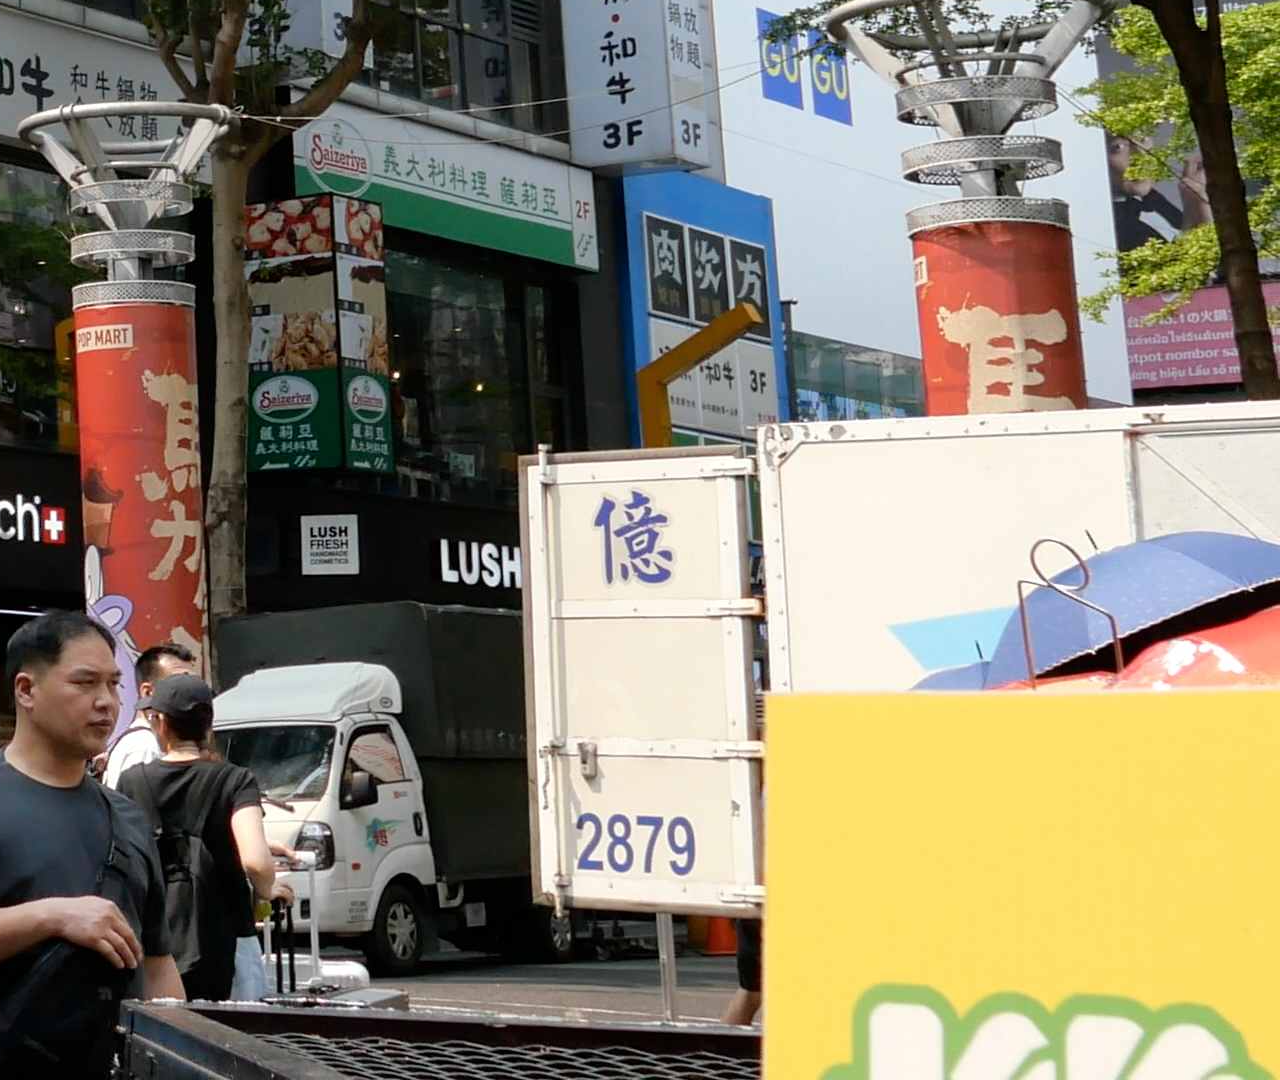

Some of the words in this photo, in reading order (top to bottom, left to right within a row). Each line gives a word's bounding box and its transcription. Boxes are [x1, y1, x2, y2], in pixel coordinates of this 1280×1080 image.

[763, 39, 799, 84] GU
[812, 53, 848, 101] GU
[602, 120, 643, 149] 3F
[681, 120, 702, 148] 3F
[311, 133, 368, 175] Saizeriya
[383, 145, 490, 199] 義大利料理
[575, 199, 590, 220] 2F
[94, 327, 130, 346] MART
[749, 369, 767, 395] 3F
[259, 390, 313, 413] Saizeriya
[310, 526, 348, 538] LUSH
[310, 538, 348, 550] FRESH
[594, 490, 674, 585] 億
[439, 538, 523, 588] LUSH
[576, 813, 696, 876] 2879
